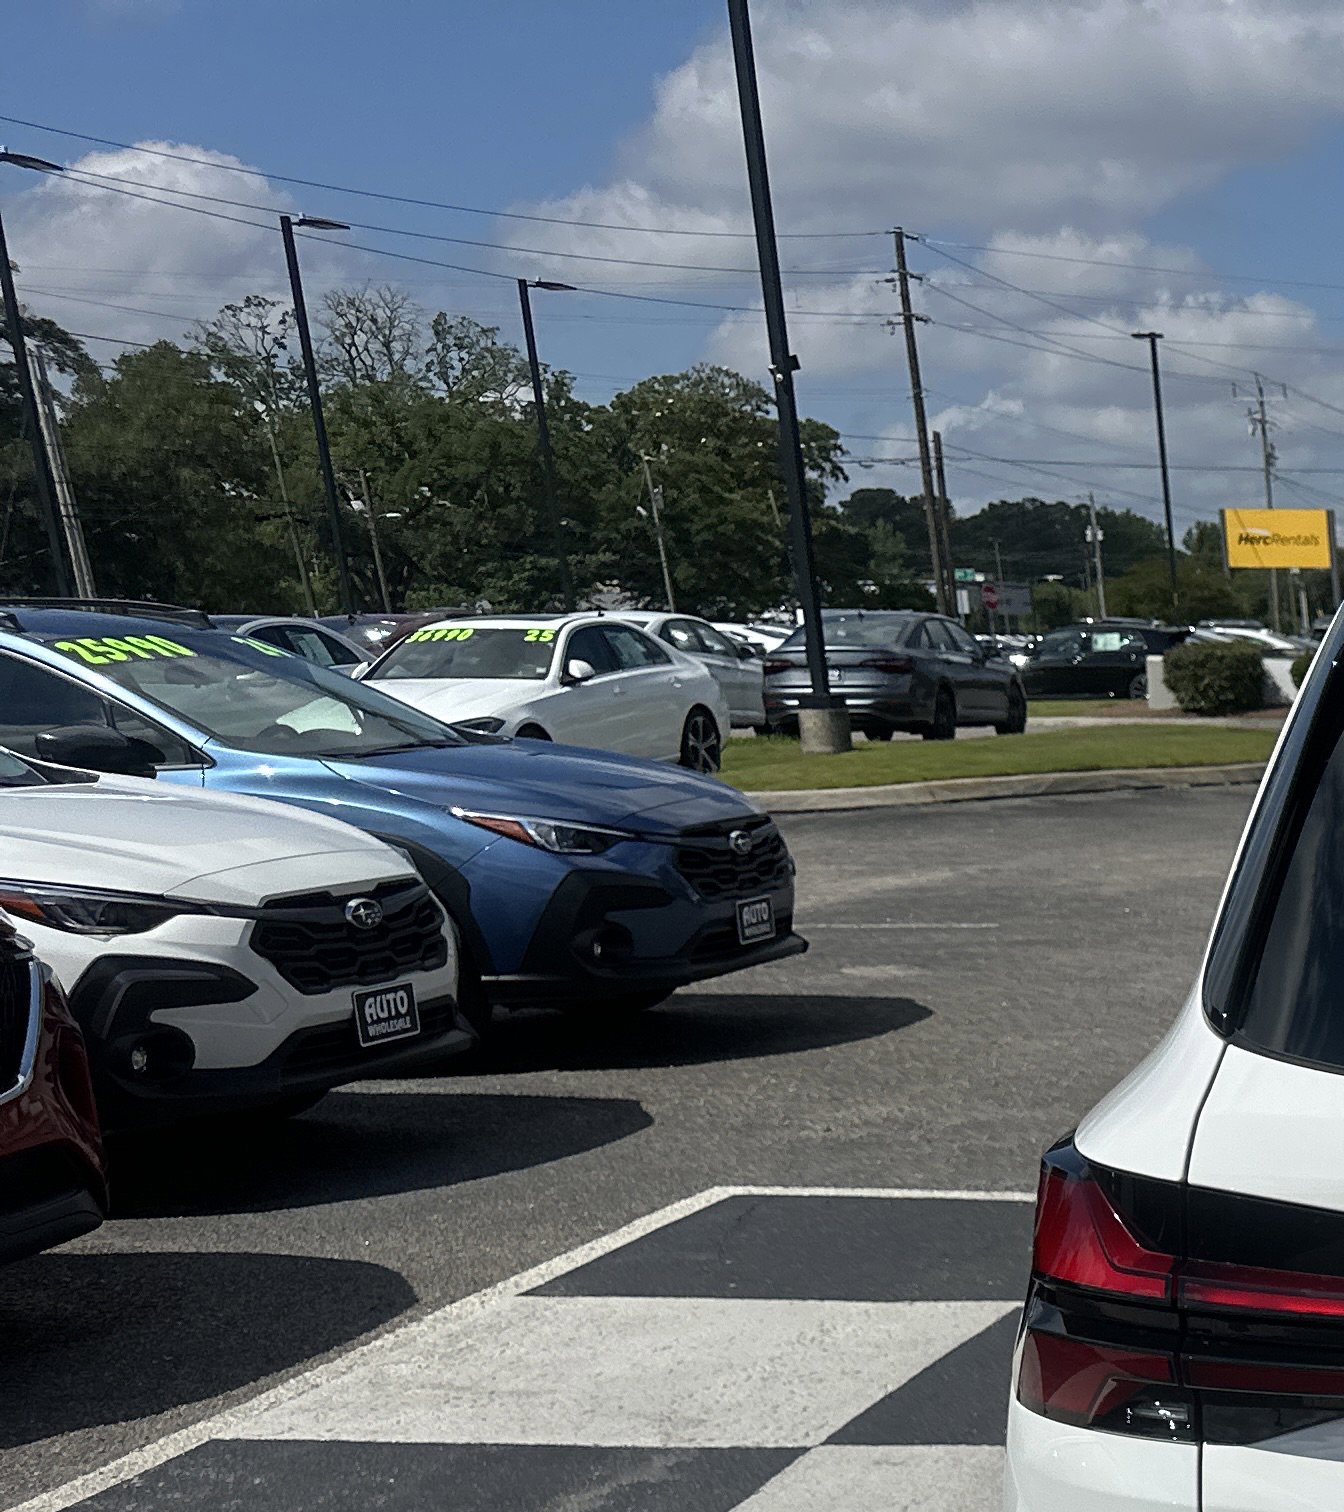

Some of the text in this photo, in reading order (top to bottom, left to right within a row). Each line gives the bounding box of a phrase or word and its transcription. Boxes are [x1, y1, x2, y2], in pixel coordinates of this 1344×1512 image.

[54, 635, 198, 664] 25990
[524, 630, 555, 642] 25
[364, 990, 409, 1024] AUTO
